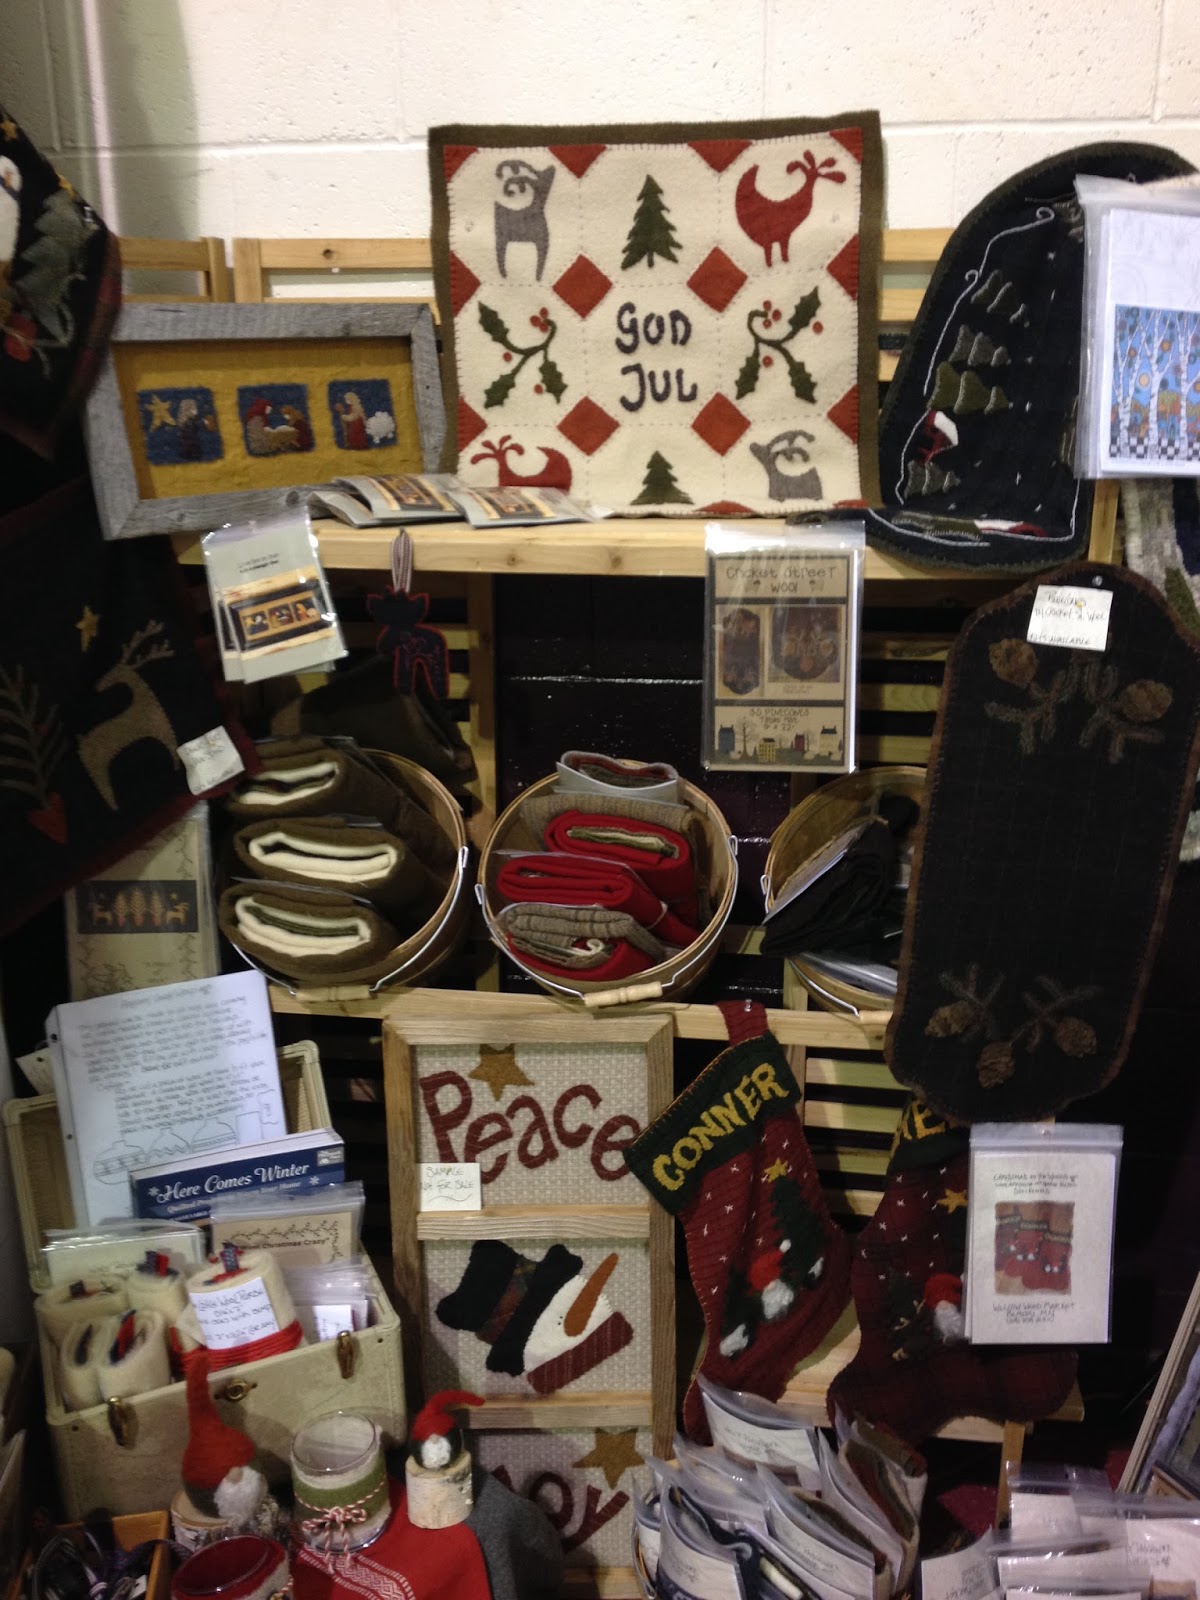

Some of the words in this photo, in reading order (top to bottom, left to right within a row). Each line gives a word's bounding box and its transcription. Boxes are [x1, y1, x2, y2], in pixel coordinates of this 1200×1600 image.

[619, 364, 698, 412] JUL
[419, 1070, 641, 1185] Peace
[652, 1063, 790, 1191] CONNER
[156, 1181, 200, 1204] Here
[204, 1174, 252, 1194] Comes
[254, 1164, 310, 1182] Winter
